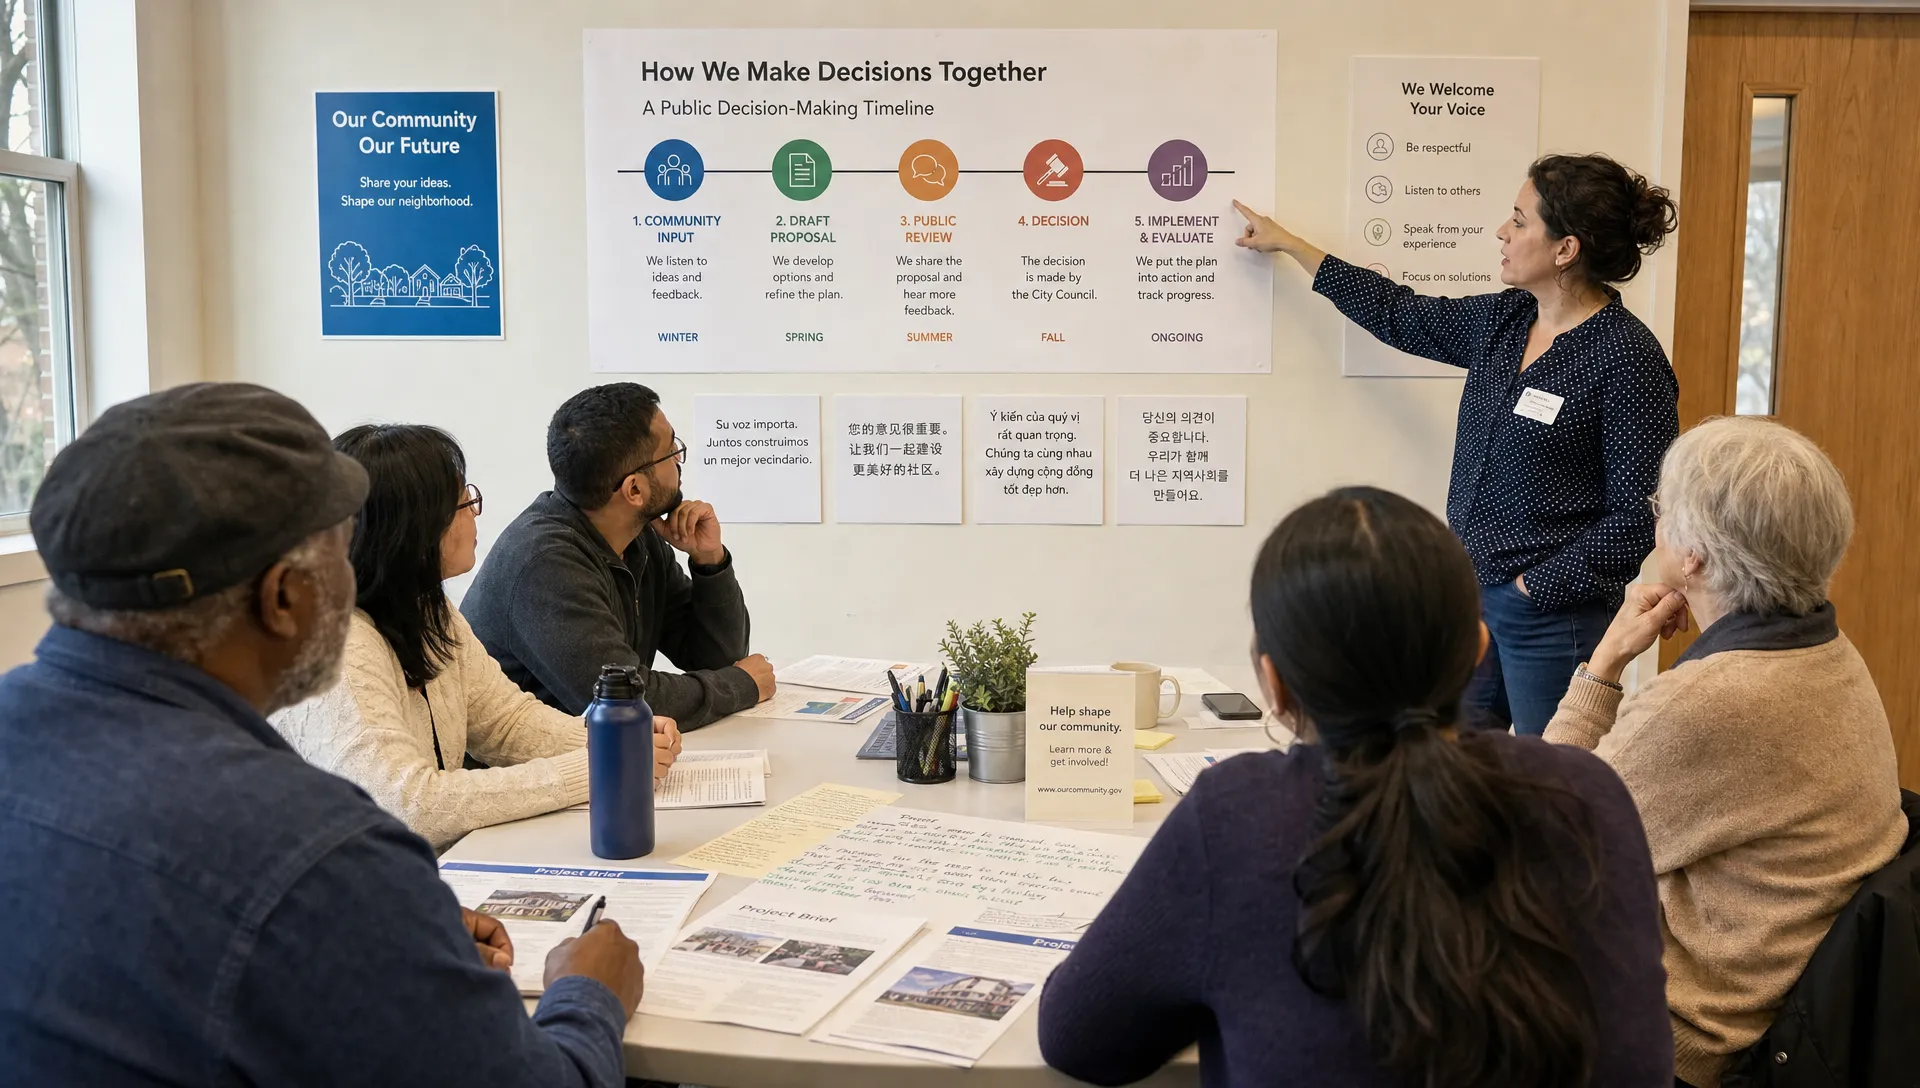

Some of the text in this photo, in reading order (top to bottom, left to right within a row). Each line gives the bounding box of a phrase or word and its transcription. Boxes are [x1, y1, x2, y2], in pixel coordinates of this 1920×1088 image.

[641, 59, 1048, 88] How We Make Decisions Together
[1401, 82, 1495, 97] We Welcome
[642, 99, 935, 121] A Public Decision-Making Timeline
[1409, 101, 1486, 116] Your Voice
[331, 109, 478, 133] Our Community
[358, 136, 461, 155] Our Future
[1406, 141, 1472, 156] Be respectful
[359, 175, 452, 191] Share your ideas.
[1404, 185, 1481, 196] Listen to others
[340, 194, 474, 210] Shape our neighborhood.
[632, 215, 722, 227] 1. COMMUNITY
[775, 215, 831, 227] 2. DRAFT
[900, 215, 957, 227] 3. PUBLIC
[1017, 215, 1089, 227] 4. DECISION
[1134, 215, 1220, 227] 5. IMPLEMENT
[657, 231, 695, 243] INPUT
[770, 231, 837, 243] PROPOSAL
[904, 231, 954, 243] REVIEW
[1403, 223, 1484, 237] Speak from your
[1139, 231, 1214, 244] & EVALUATE
[1402, 238, 1457, 251] experience
[645, 255, 708, 266] We listen to
[772, 255, 834, 269] We develop
[895, 255, 963, 266] We share the
[1020, 255, 1086, 267] The decision
[1135, 255, 1218, 269] We put the plan
[652, 271, 702, 283] ideas and
[772, 271, 834, 285] options and
[896, 271, 963, 285] proposal and
[1025, 271, 1082, 286] is made by
[1138, 271, 1215, 283] into action and
[1402, 271, 1492, 282] Focus on solutions
[651, 288, 703, 300] feedback.
[765, 288, 844, 303] refine the plan.
[903, 288, 956, 300] hear more
[1011, 288, 1098, 303] the City Council.
[1137, 289, 1215, 303] track progress.
[904, 304, 955, 316] feedback.
[657, 332, 699, 342] WINTER
[785, 332, 824, 342] SPRING
[906, 332, 953, 342] SUMMER
[1041, 332, 1066, 343] FALL
[1150, 332, 1204, 343] ONGOING
[715, 418, 798, 432] Su voz importa.
[1047, 411, 1069, 425] quý
[1070, 411, 1080, 424] vị
[1142, 411, 1215, 425] 당신의 의견이
[848, 422, 948, 436] 您的意见很重要。
[997, 428, 1077, 443] rất quan trọng.
[706, 436, 809, 448] Juntos construimos
[1147, 430, 1209, 444] 중요합니다.
[848, 442, 943, 456] 让我们一起建设
[985, 447, 1092, 461] Chúng ta cùng nhau
[703, 453, 813, 468] un mejor vecindario.
[1147, 450, 1183, 464] 우리가
[852, 462, 940, 477] 更美好的社区。
[1129, 469, 1229, 483] 더 나은 지역사회를
[1003, 482, 1020, 495] tốt
[1045, 483, 1069, 495] hơn.
[1153, 488, 1203, 502] 만들어요.
[1050, 705, 1111, 719] Help shape
[1039, 721, 1122, 735] our community.
[1049, 744, 1112, 755] Learn more &
[1050, 756, 1109, 768] get involved!
[1037, 786, 1123, 796] www.ourcommunity.gov
[534, 866, 625, 879] Project Brief
[738, 904, 839, 924] Project Brief
